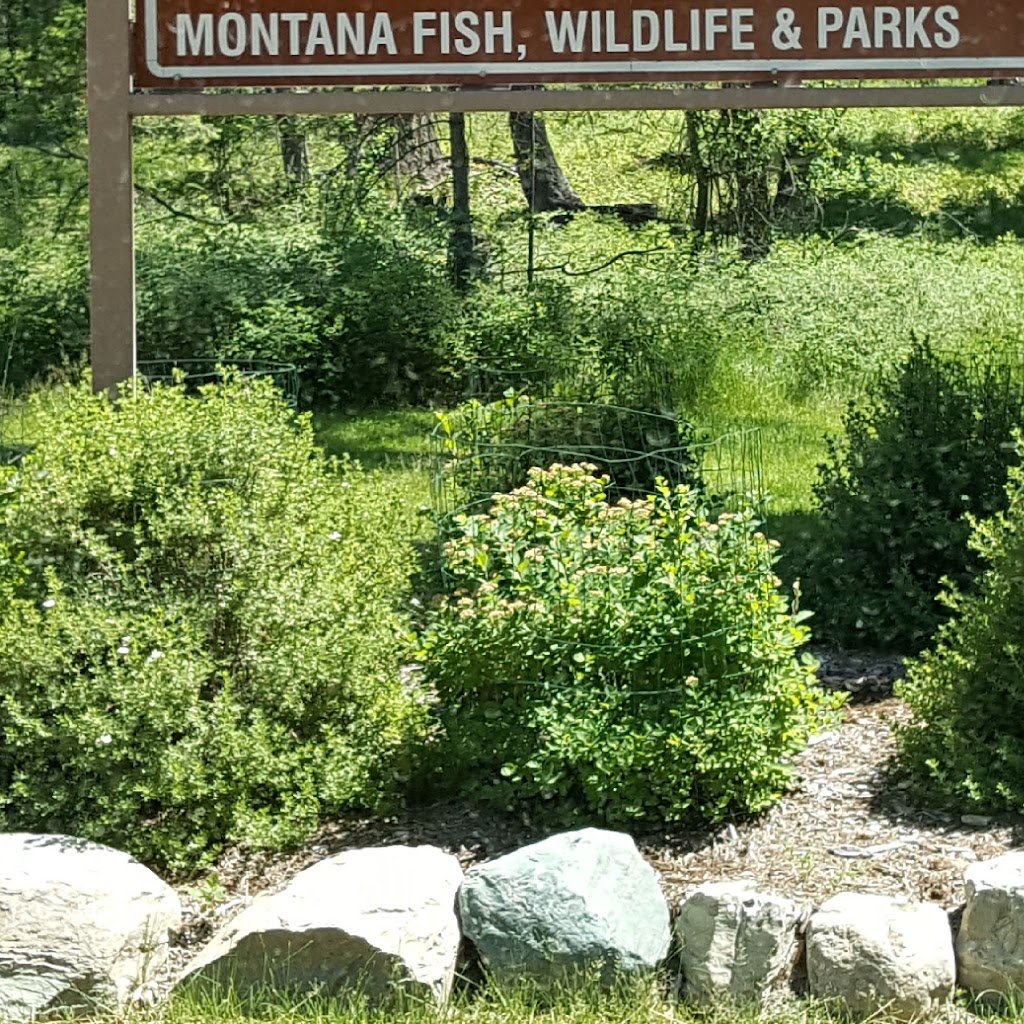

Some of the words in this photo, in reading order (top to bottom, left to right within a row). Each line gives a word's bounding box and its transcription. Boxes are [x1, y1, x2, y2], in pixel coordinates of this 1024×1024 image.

[176, 12, 398, 56] MONTANA
[412, 10, 527, 60] FISH,
[545, 8, 755, 53] WILDLIFE
[771, 7, 802, 51] &
[817, 5, 960, 50] PARKS
